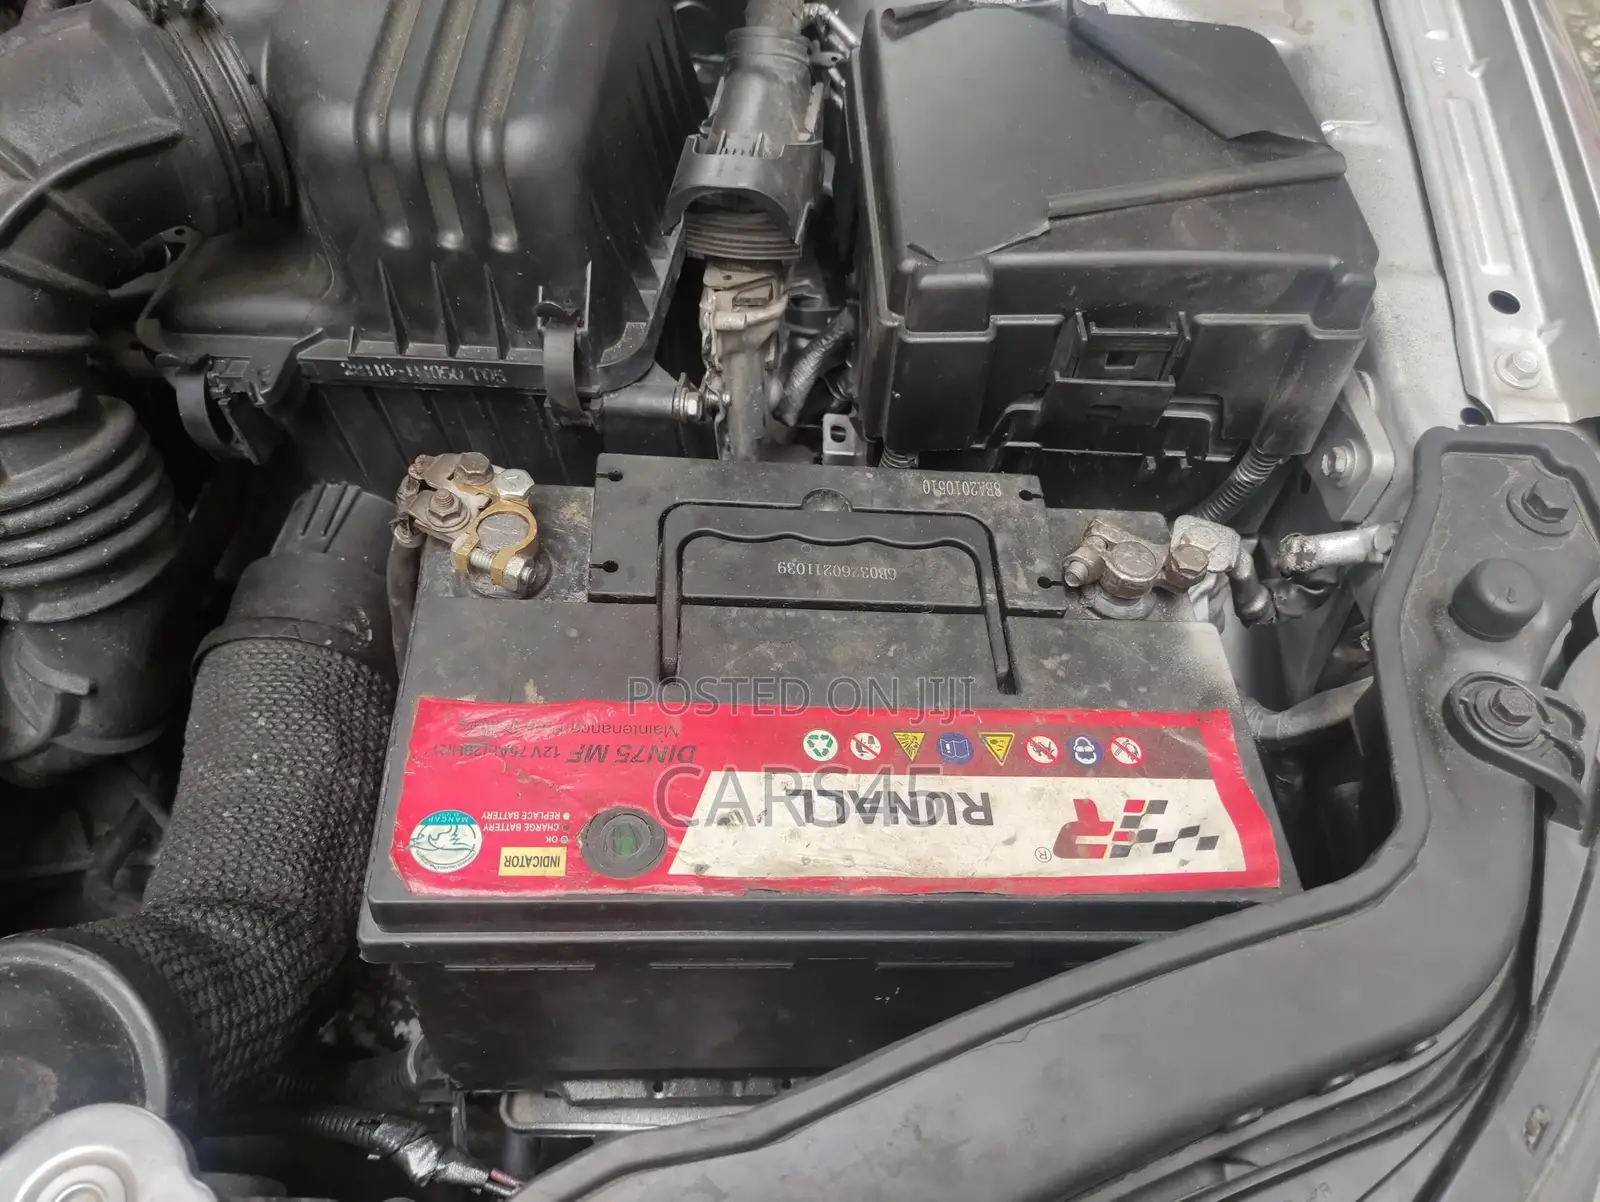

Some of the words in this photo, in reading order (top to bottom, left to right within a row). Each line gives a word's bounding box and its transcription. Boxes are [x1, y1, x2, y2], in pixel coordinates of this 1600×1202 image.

[922, 479, 1002, 498] 8BA2010510
[776, 561, 897, 581] 6B03260211039
[530, 745, 561, 759] 12V
[566, 744, 610, 764] MF
[616, 744, 697, 764] DIN75
[785, 788, 995, 827] RUNALL
[428, 815, 469, 824] MANCAP
[481, 810, 519, 820] BATTERY
[520, 810, 560, 820] REPLACE
[483, 822, 521, 832] BATTERY
[523, 822, 560, 832] CHARGE
[545, 835, 558, 844] OK
[504, 854, 561, 868] INDICATOR
